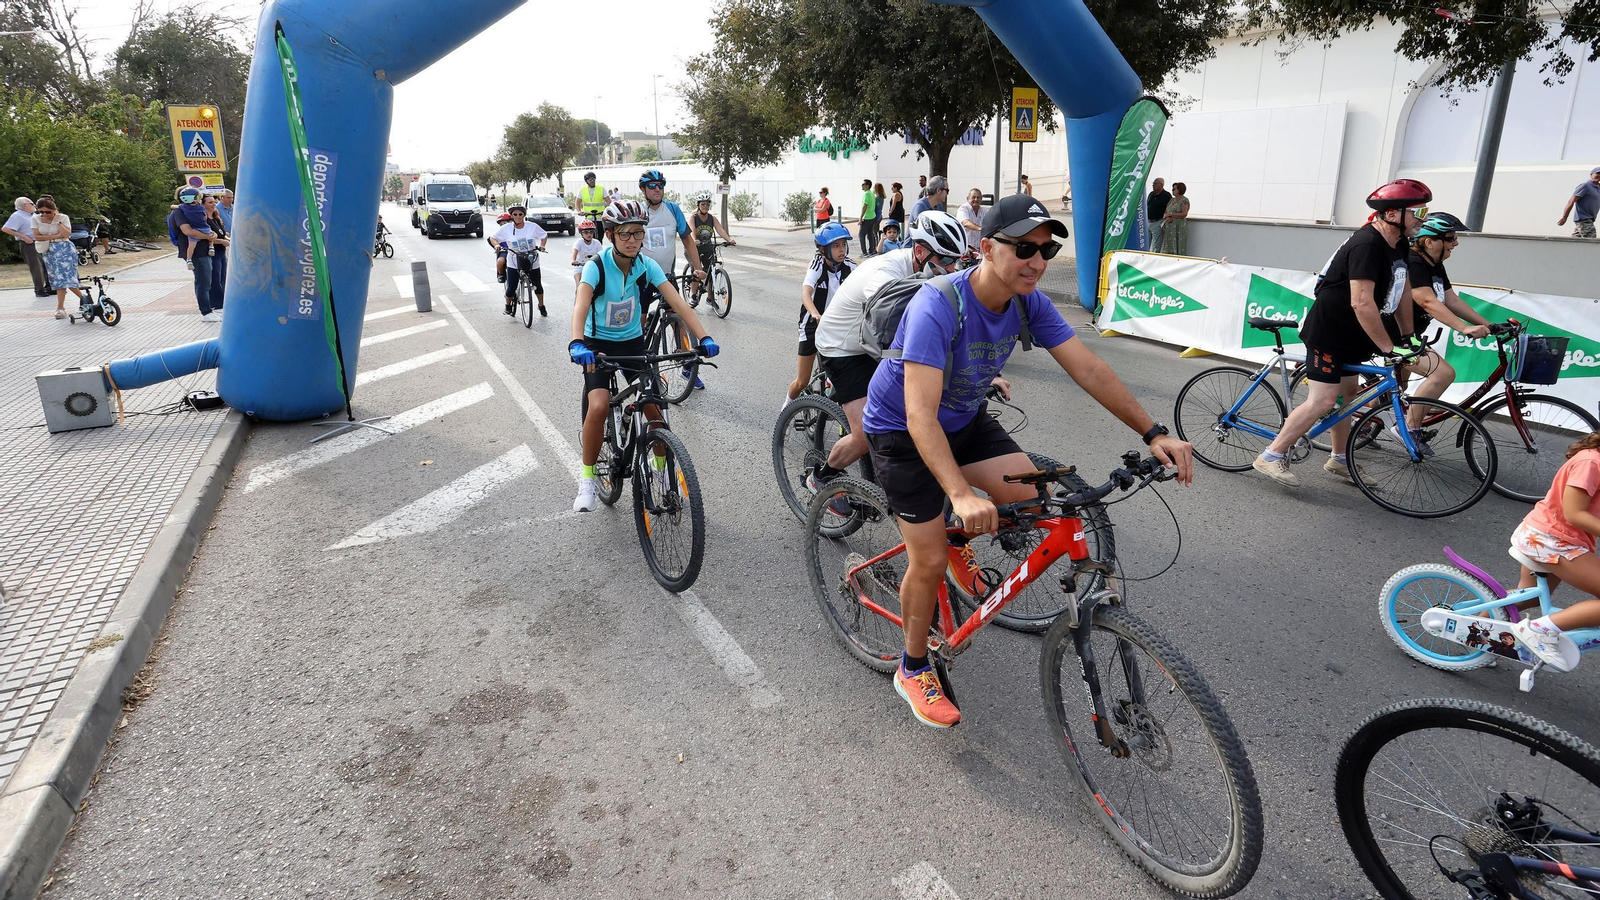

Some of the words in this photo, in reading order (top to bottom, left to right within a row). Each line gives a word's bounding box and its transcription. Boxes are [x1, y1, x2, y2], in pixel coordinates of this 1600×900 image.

[176, 119, 214, 128] ATENCION
[1014, 131, 1034, 140] PEATONES
[183, 160, 221, 169] PEATONES
[1118, 283, 1128, 298] El
[1127, 285, 1150, 302] Corte
[1149, 286, 1185, 310] Inglés
[1247, 302, 1262, 319] El
[968, 350, 985, 361] DON
[980, 559, 1029, 621] BH
